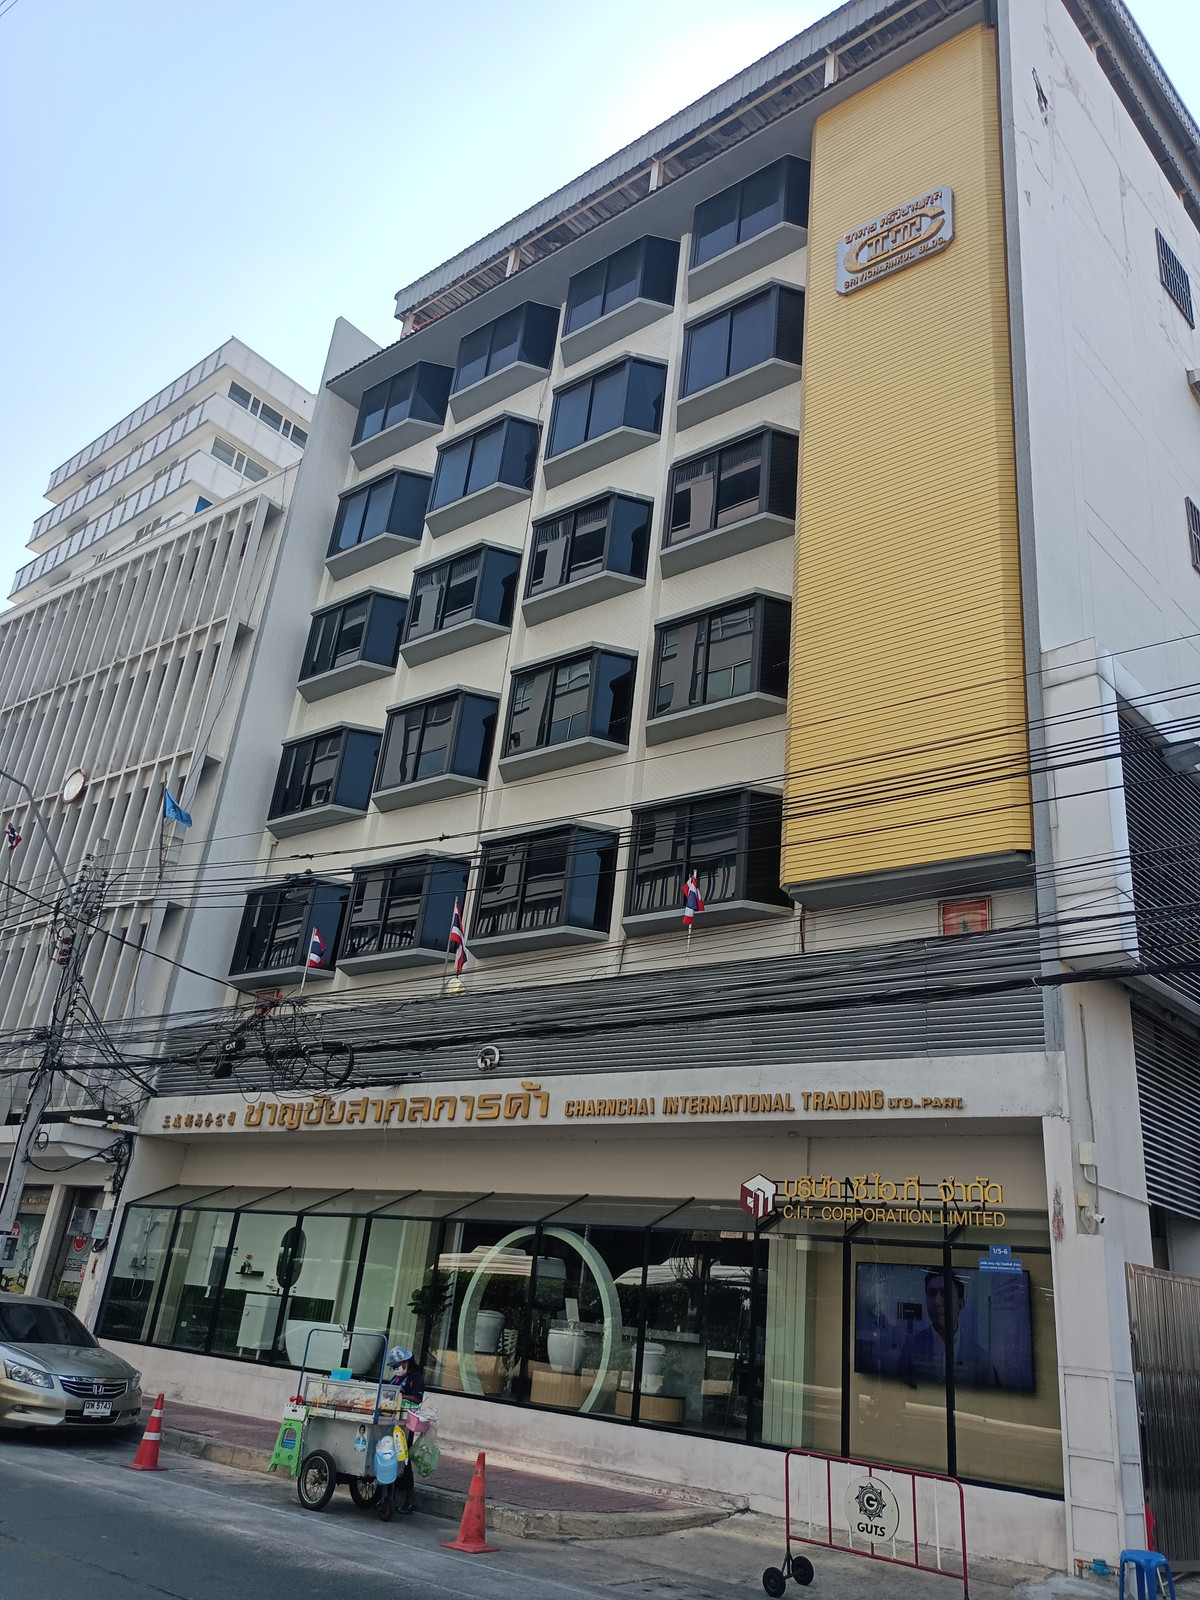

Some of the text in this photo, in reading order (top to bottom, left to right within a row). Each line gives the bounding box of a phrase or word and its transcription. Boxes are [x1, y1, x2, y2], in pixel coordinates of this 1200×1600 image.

[845, 222, 877, 244] อาคาร
[244, 1082, 549, 1130] ชาญชัยสากลการค้า
[564, 1097, 655, 1117] CHARNCHAI
[662, 1093, 795, 1114] INTERNATIONAL
[801, 1090, 884, 1110] TRADING
[783, 1174, 842, 1199] บริษัท
[939, 1176, 1003, 1203] จำกัด
[783, 1204, 1007, 1227] C.I.T. CORPORATION LIMITED
[857, 1522, 886, 1537] GUTS
